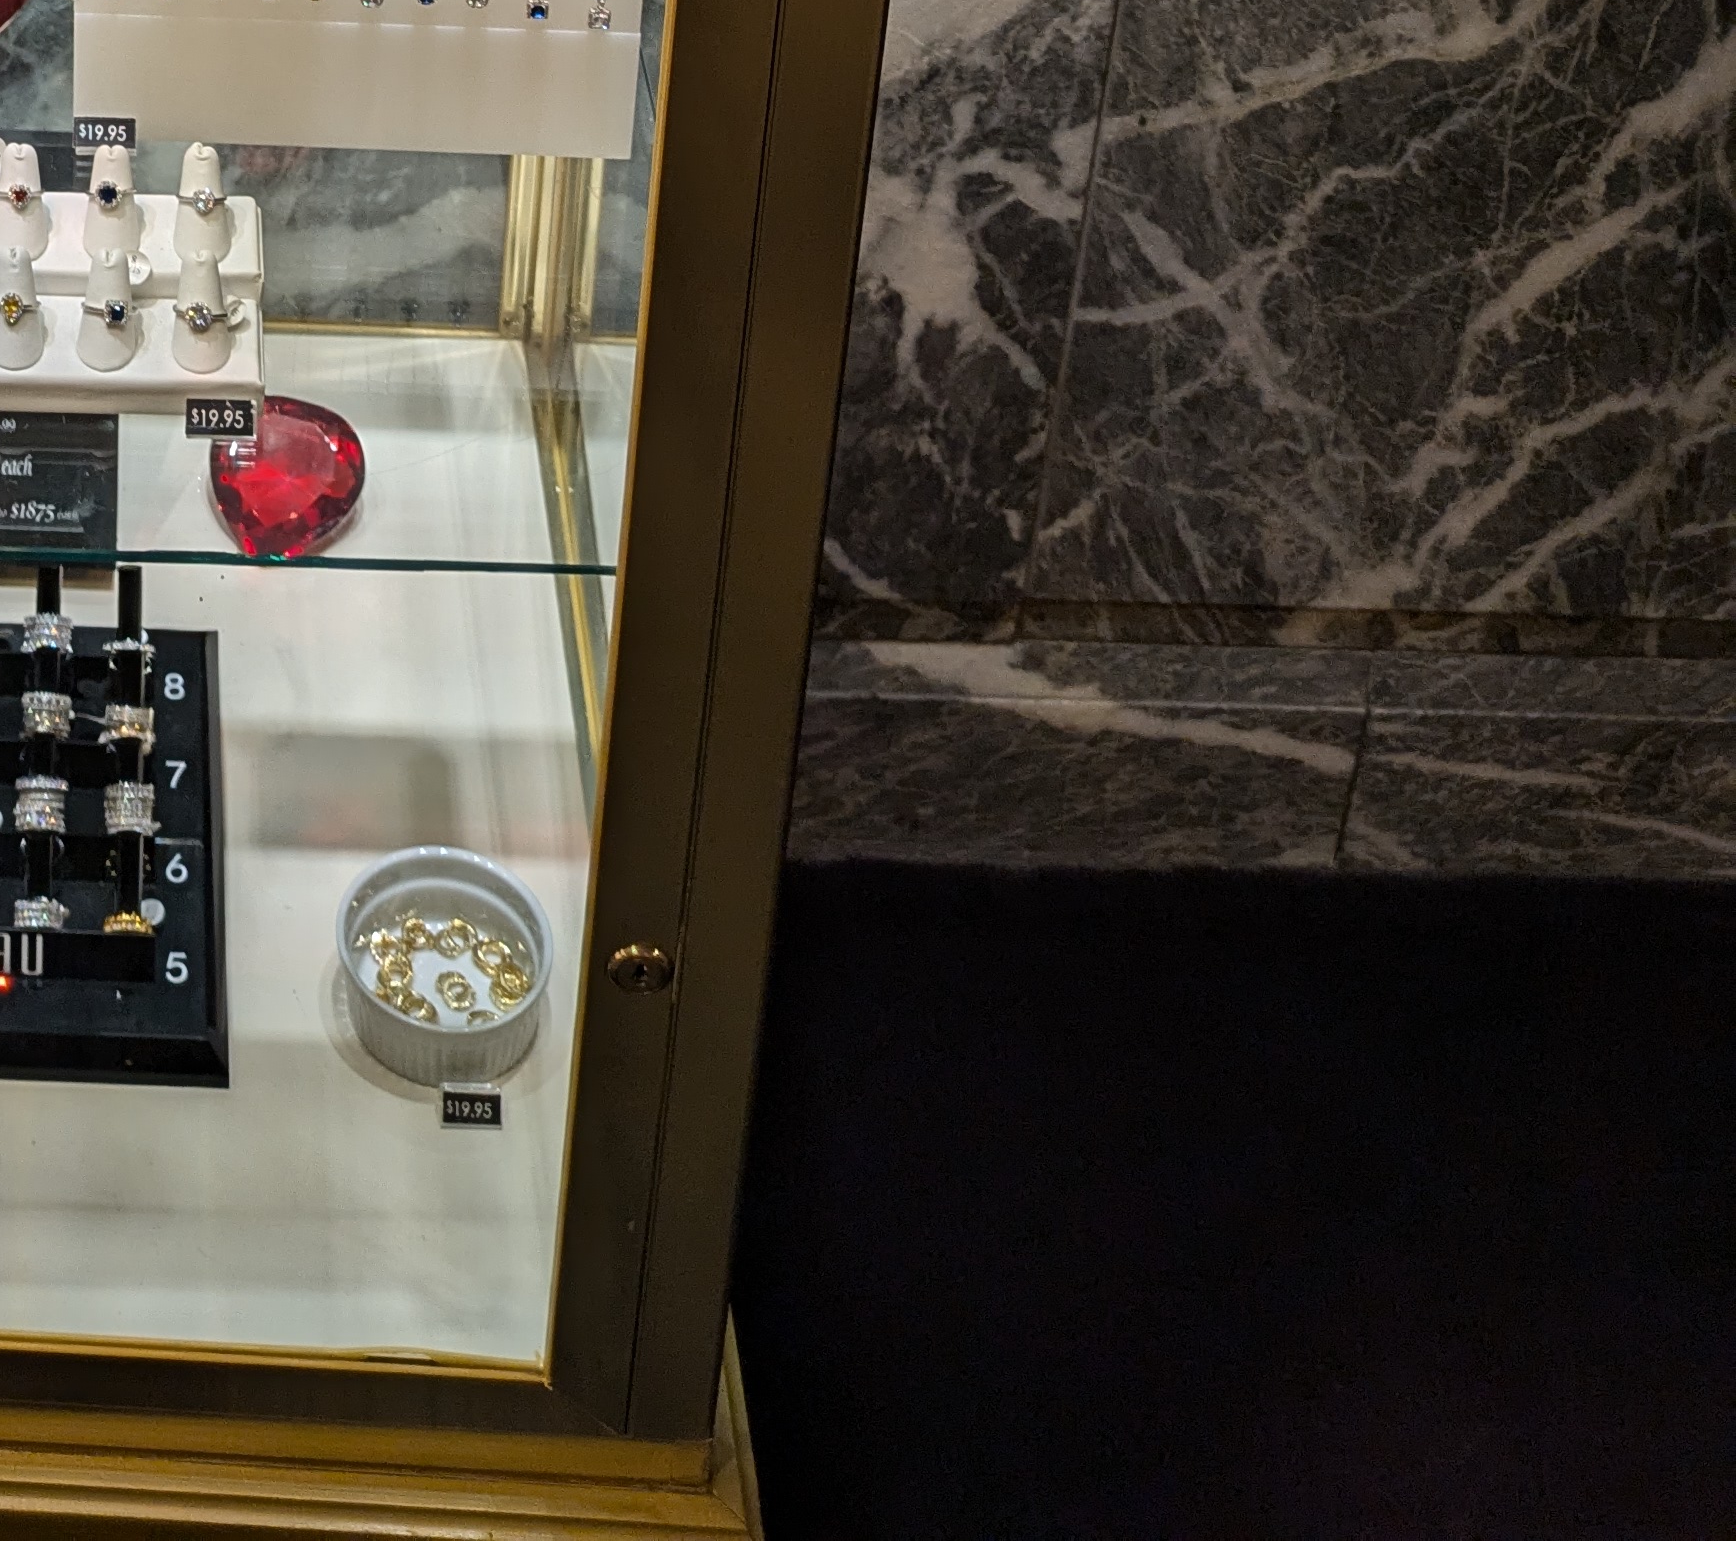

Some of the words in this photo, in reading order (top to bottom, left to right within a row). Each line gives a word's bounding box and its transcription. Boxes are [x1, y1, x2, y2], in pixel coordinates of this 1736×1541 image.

[78, 123, 127, 142] $19.95
[191, 407, 245, 429] $19.95
[1, 454, 33, 477] each
[163, 673, 187, 702] 8
[164, 762, 188, 790] 7
[165, 854, 189, 884] 6
[165, 951, 189, 984] 5
[445, 1099, 493, 1119] $19.95
